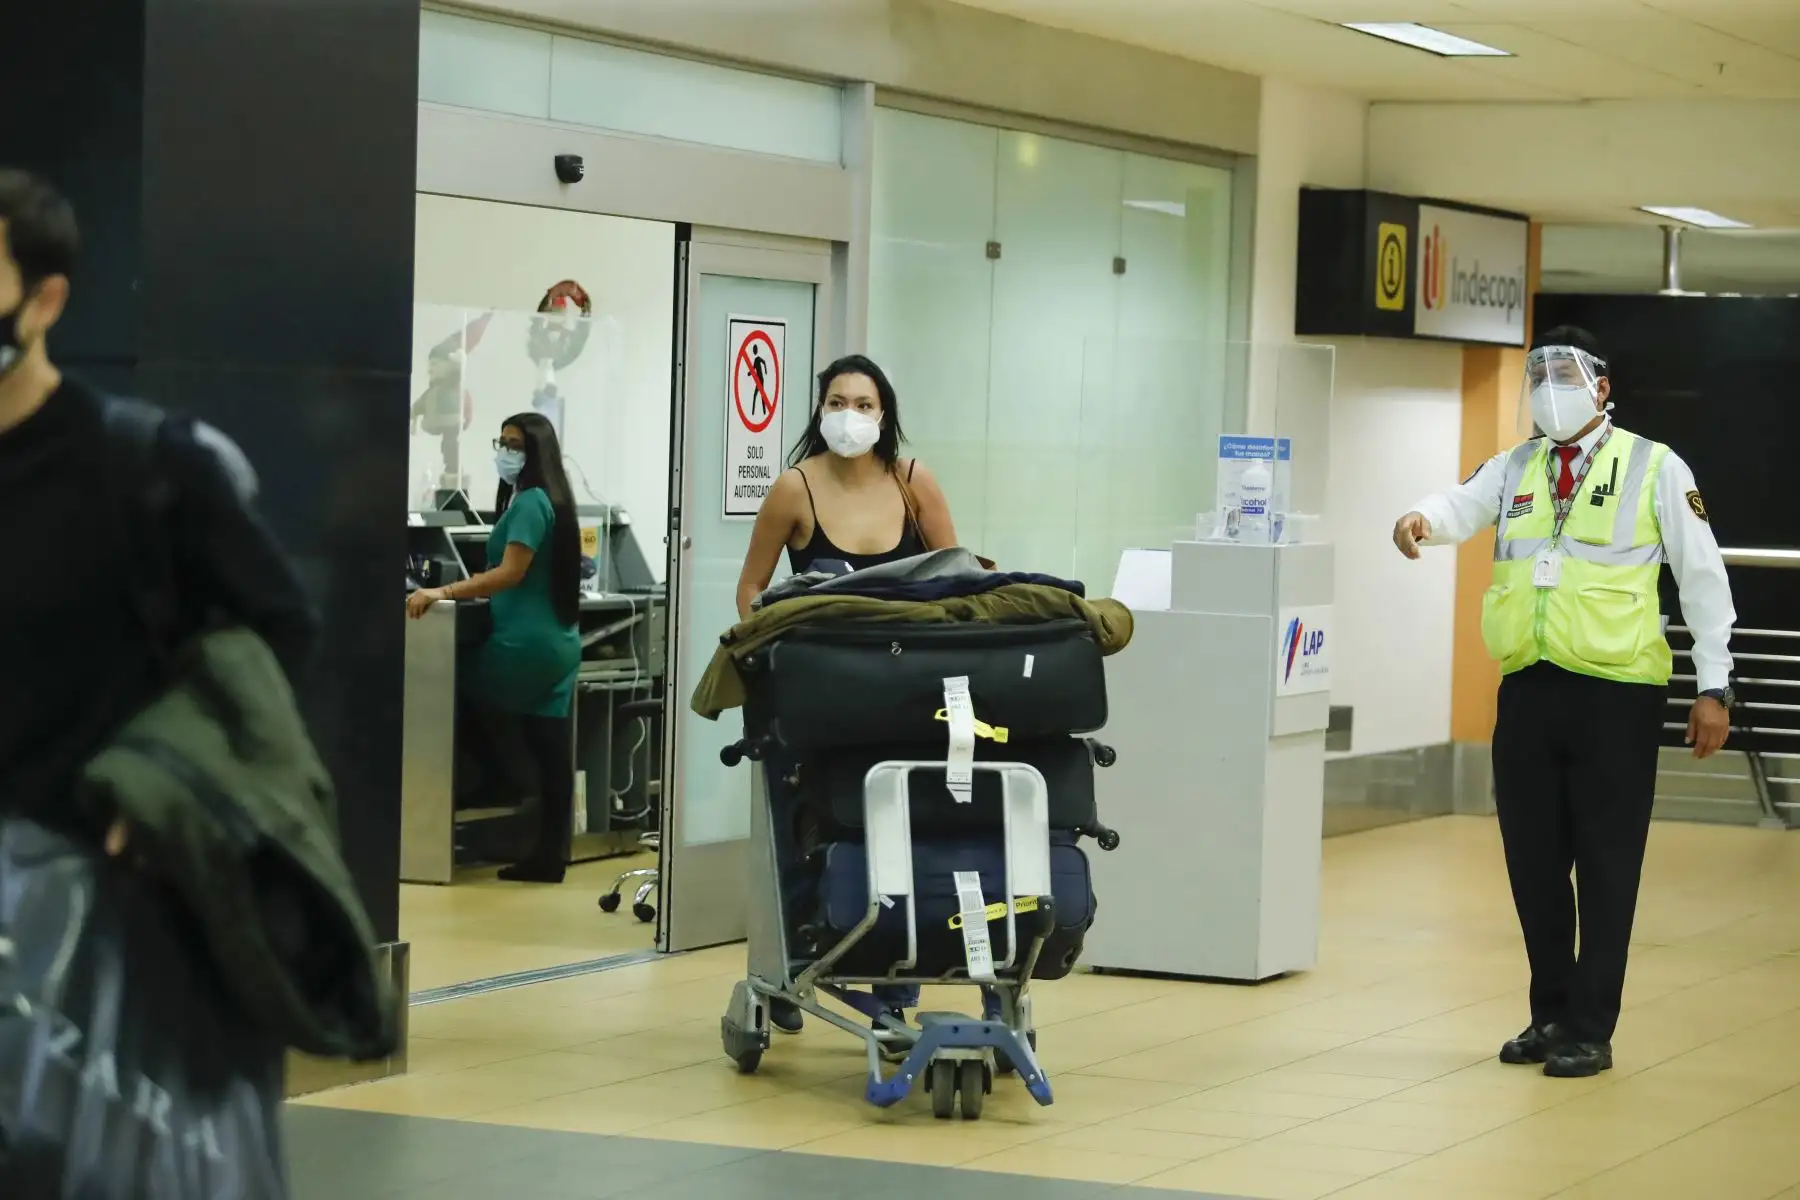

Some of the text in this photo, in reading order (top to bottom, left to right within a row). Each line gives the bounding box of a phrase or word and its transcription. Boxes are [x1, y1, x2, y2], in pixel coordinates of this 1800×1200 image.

[1451, 256, 1523, 324] Indecopi
[747, 445, 764, 459] SOLO
[738, 465, 771, 479] PERSONAL
[734, 484, 774, 498] AUTORIZAD
[1303, 630, 1324, 656] LAP
[1015, 899, 1038, 908] Priorit
